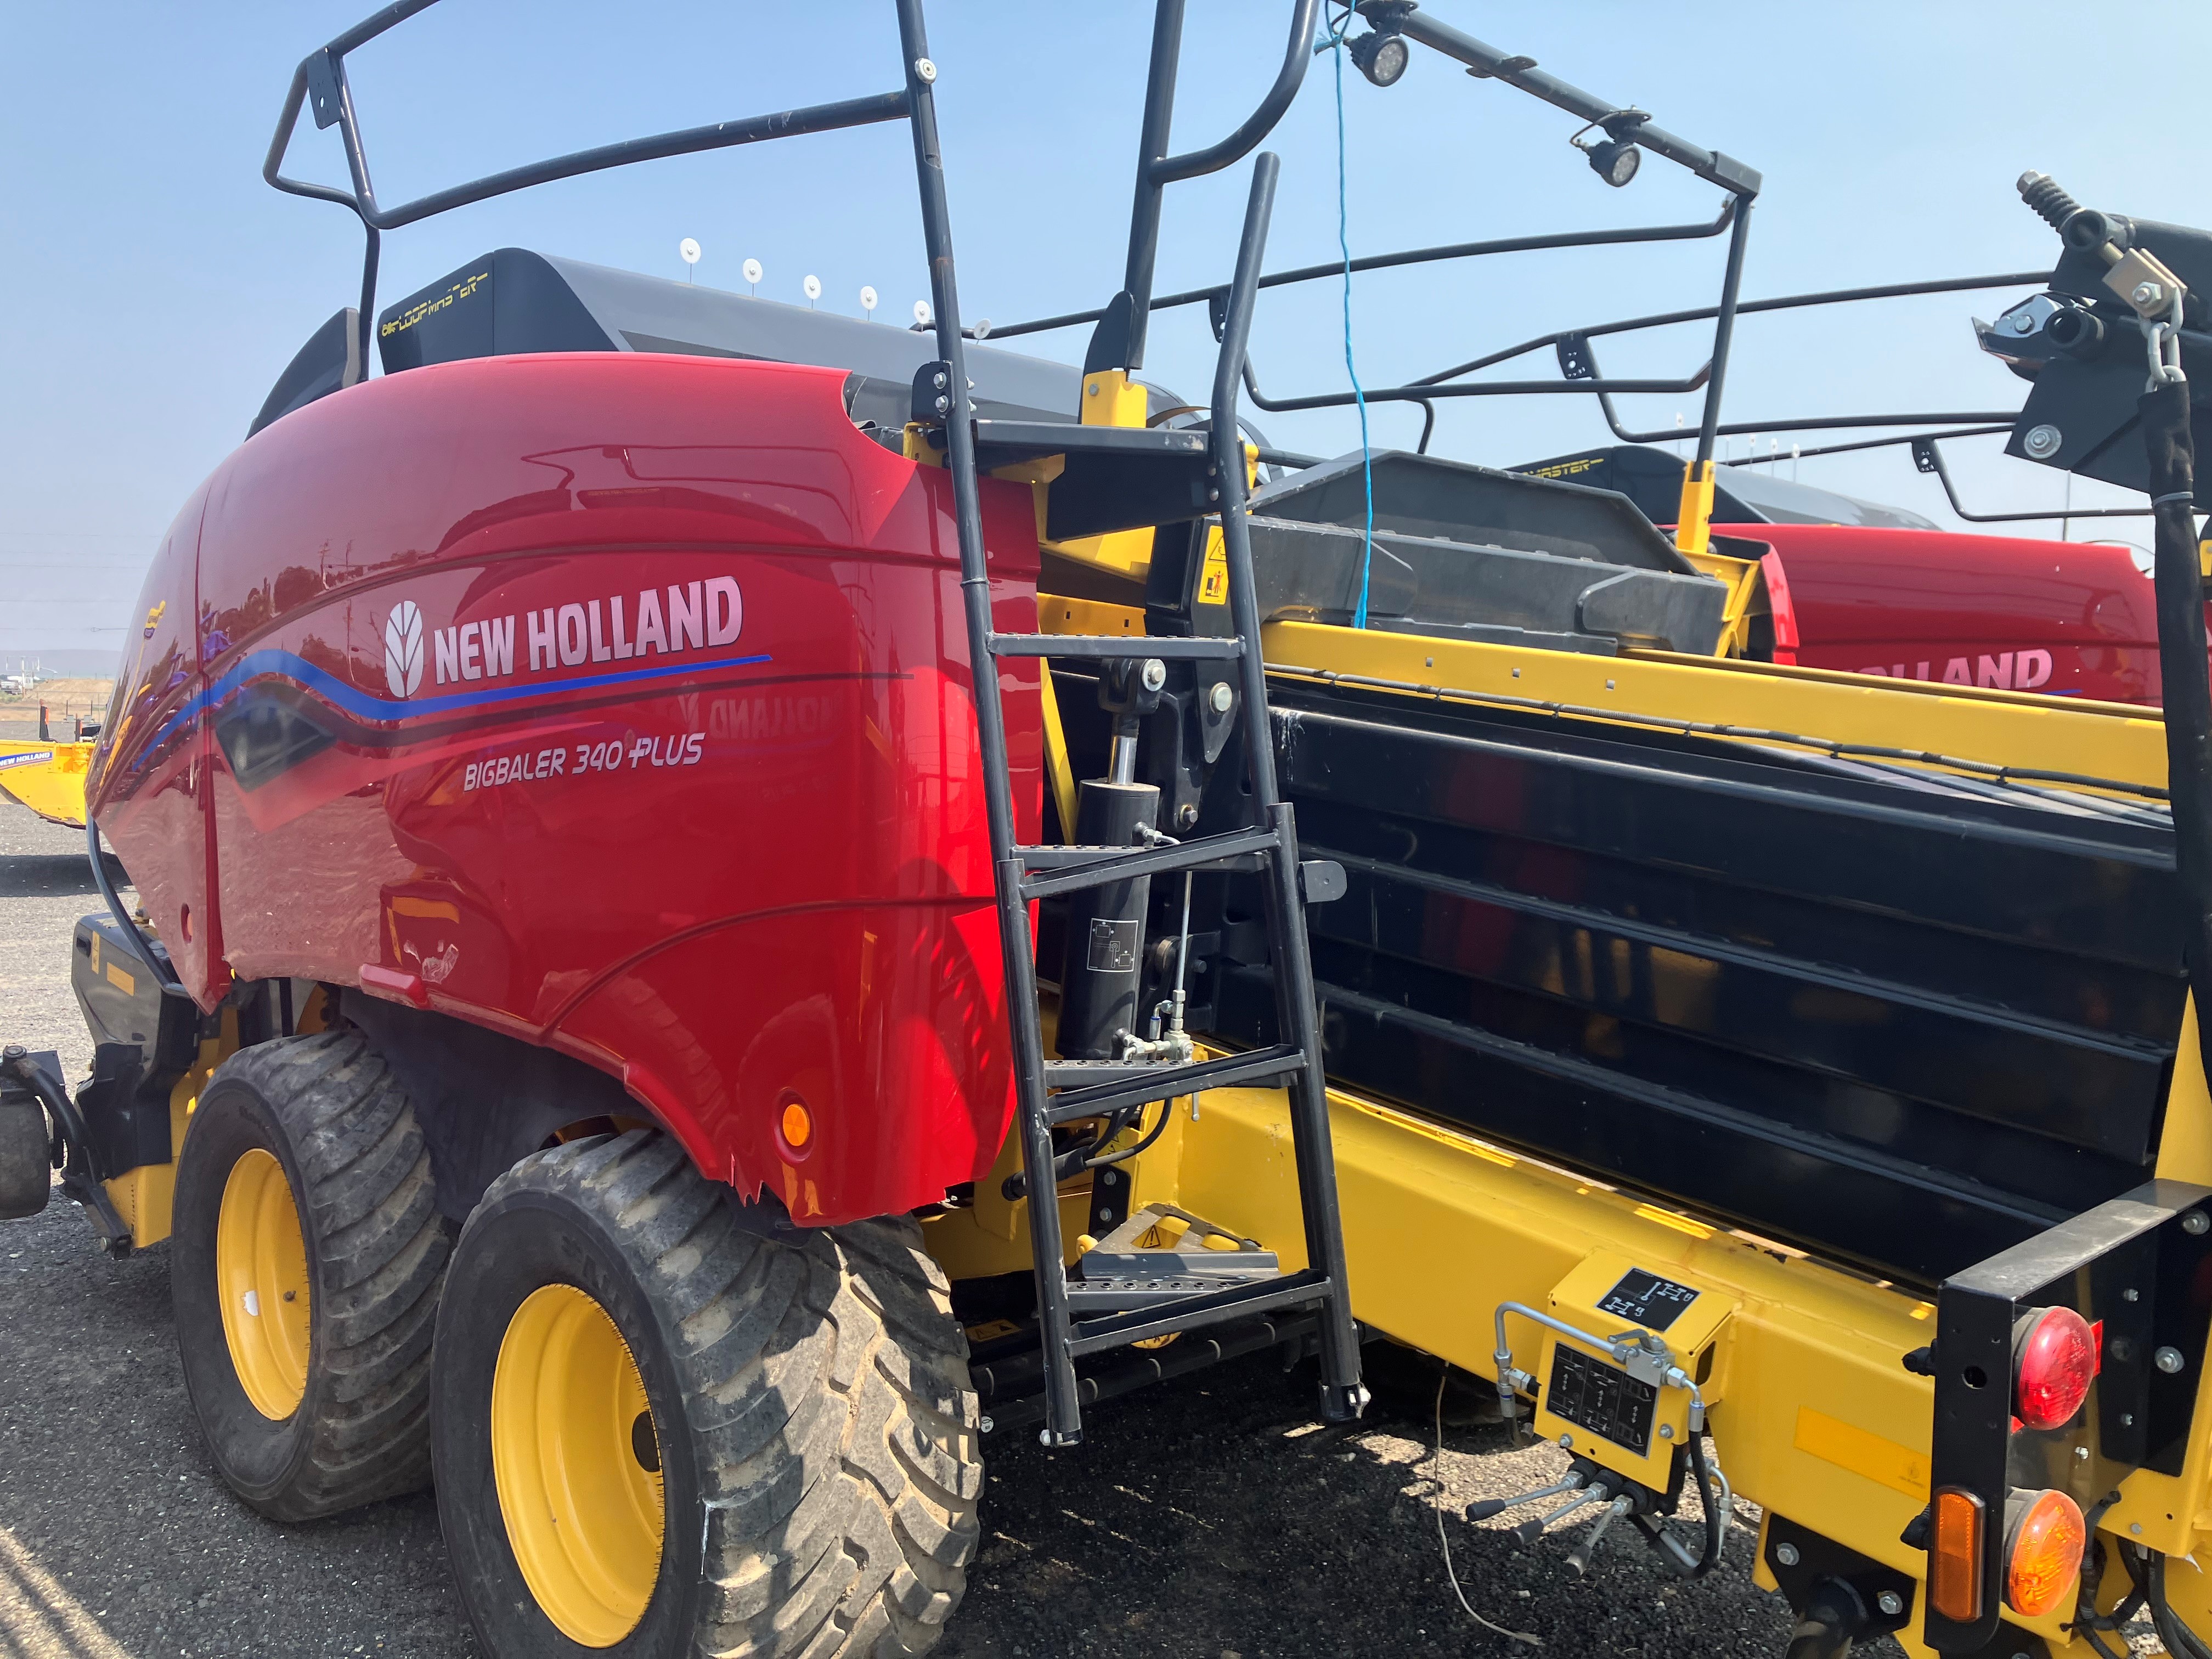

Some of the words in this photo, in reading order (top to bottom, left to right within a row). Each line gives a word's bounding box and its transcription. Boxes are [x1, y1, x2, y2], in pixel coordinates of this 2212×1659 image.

[434, 615, 515, 685] NEW
[527, 575, 743, 672] HOLLAND
[16, 752, 50, 763] HOLLAND
[463, 748, 566, 792] BIGBALER
[572, 740, 623, 774] 340
